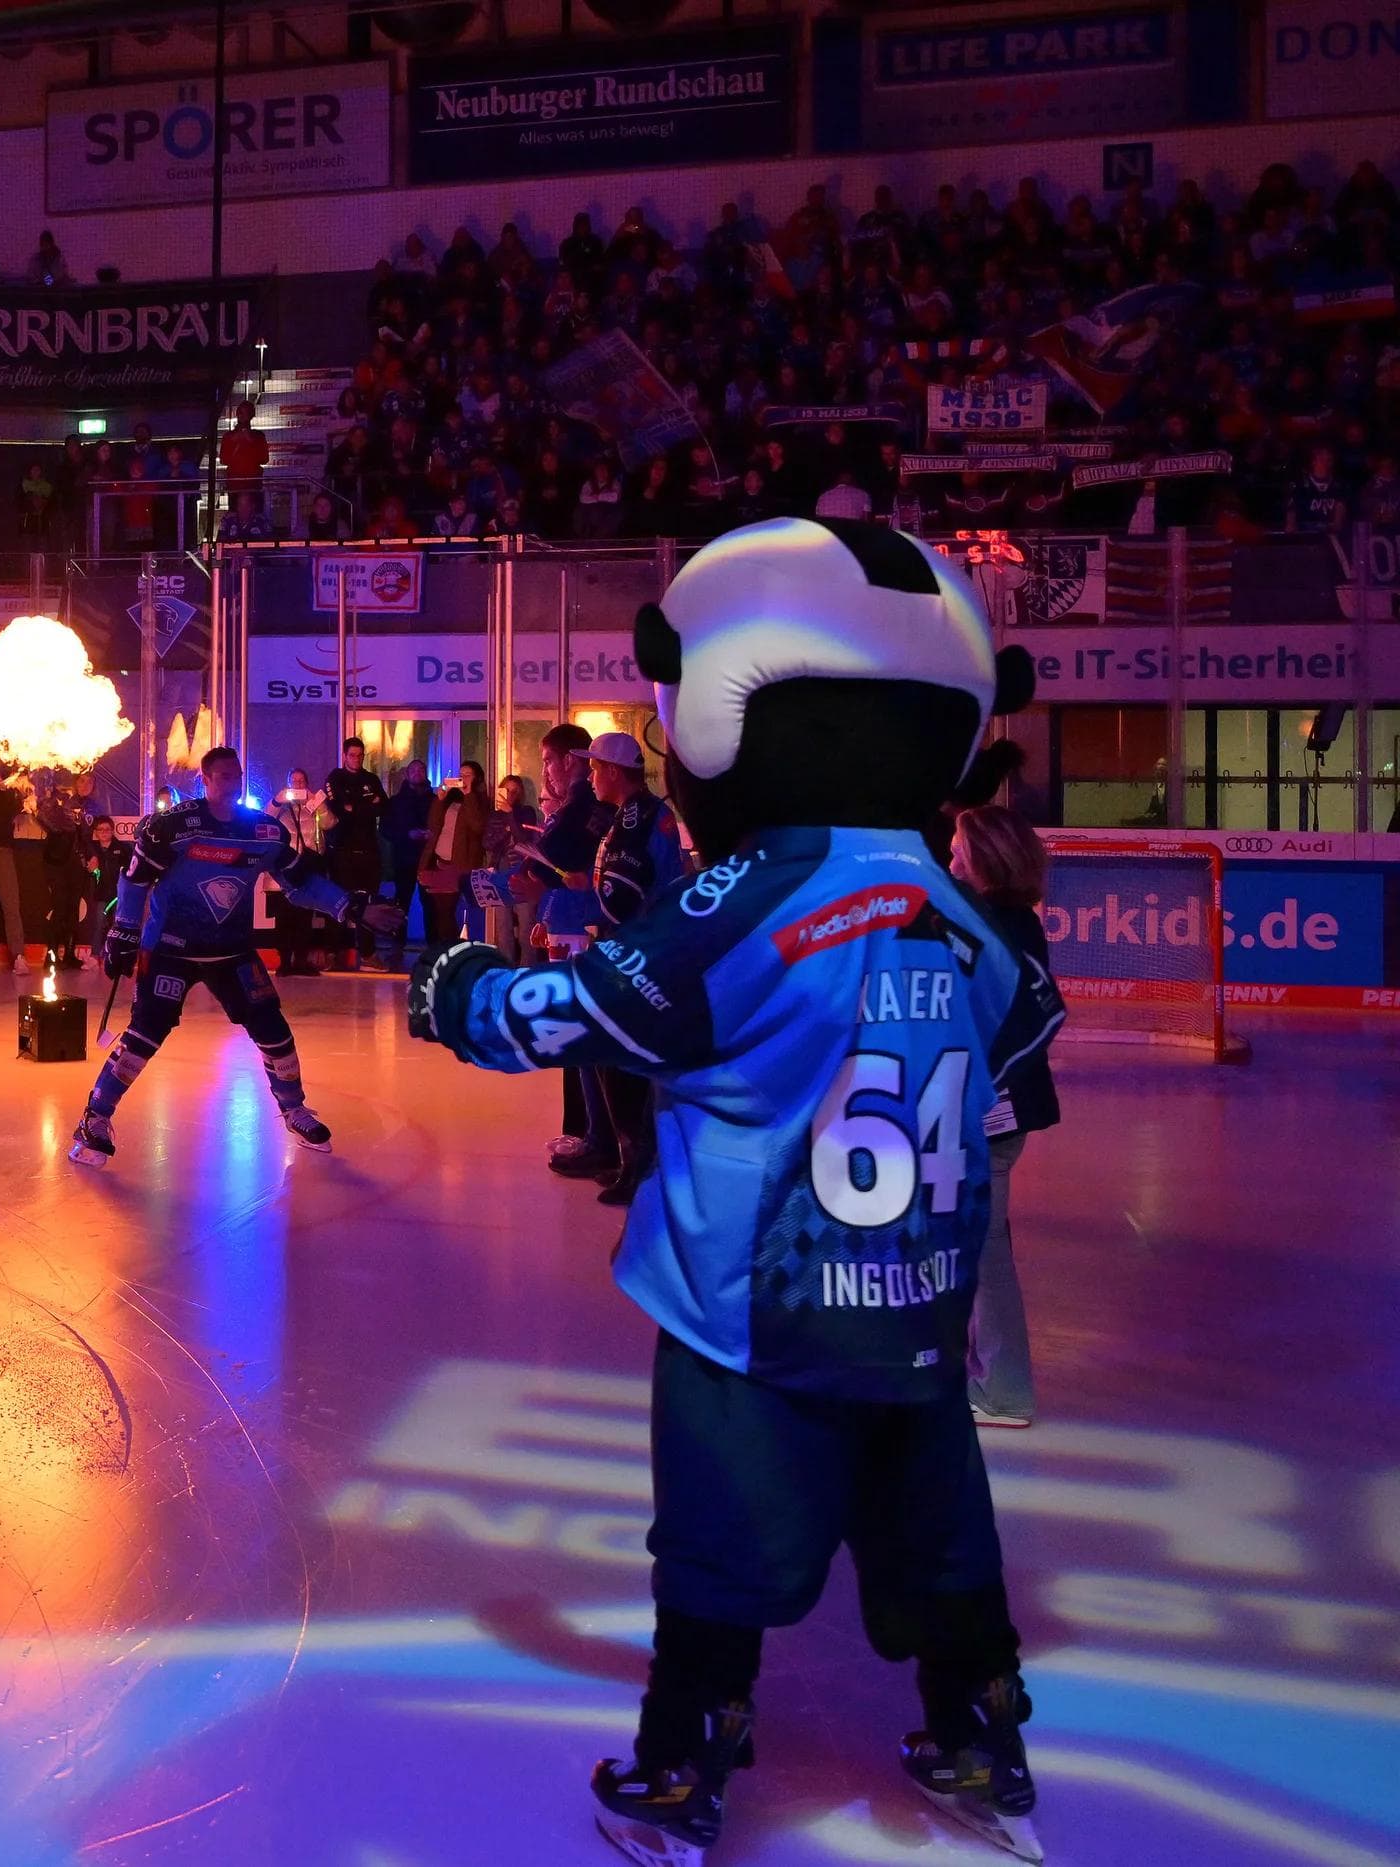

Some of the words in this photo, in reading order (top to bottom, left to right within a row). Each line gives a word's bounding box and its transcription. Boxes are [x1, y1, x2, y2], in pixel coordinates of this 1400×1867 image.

[892, 36, 989, 74] LIFE
[1004, 20, 1152, 66] PARK
[435, 86, 587, 120] Neuburger
[593, 66, 765, 107] Rundschau
[85, 85, 344, 166] SPÖRER
[518, 130, 551, 145] Alles
[556, 128, 584, 141] was
[166, 165, 221, 181] Gesun
[941, 388, 1033, 408] MERC
[416, 655, 485, 684] Das
[267, 680, 377, 701] SysTec
[1281, 838, 1334, 854] Audi
[1222, 985, 1288, 1003] ENNY
[509, 971, 591, 1056] 64
[811, 1050, 970, 1228] 64
